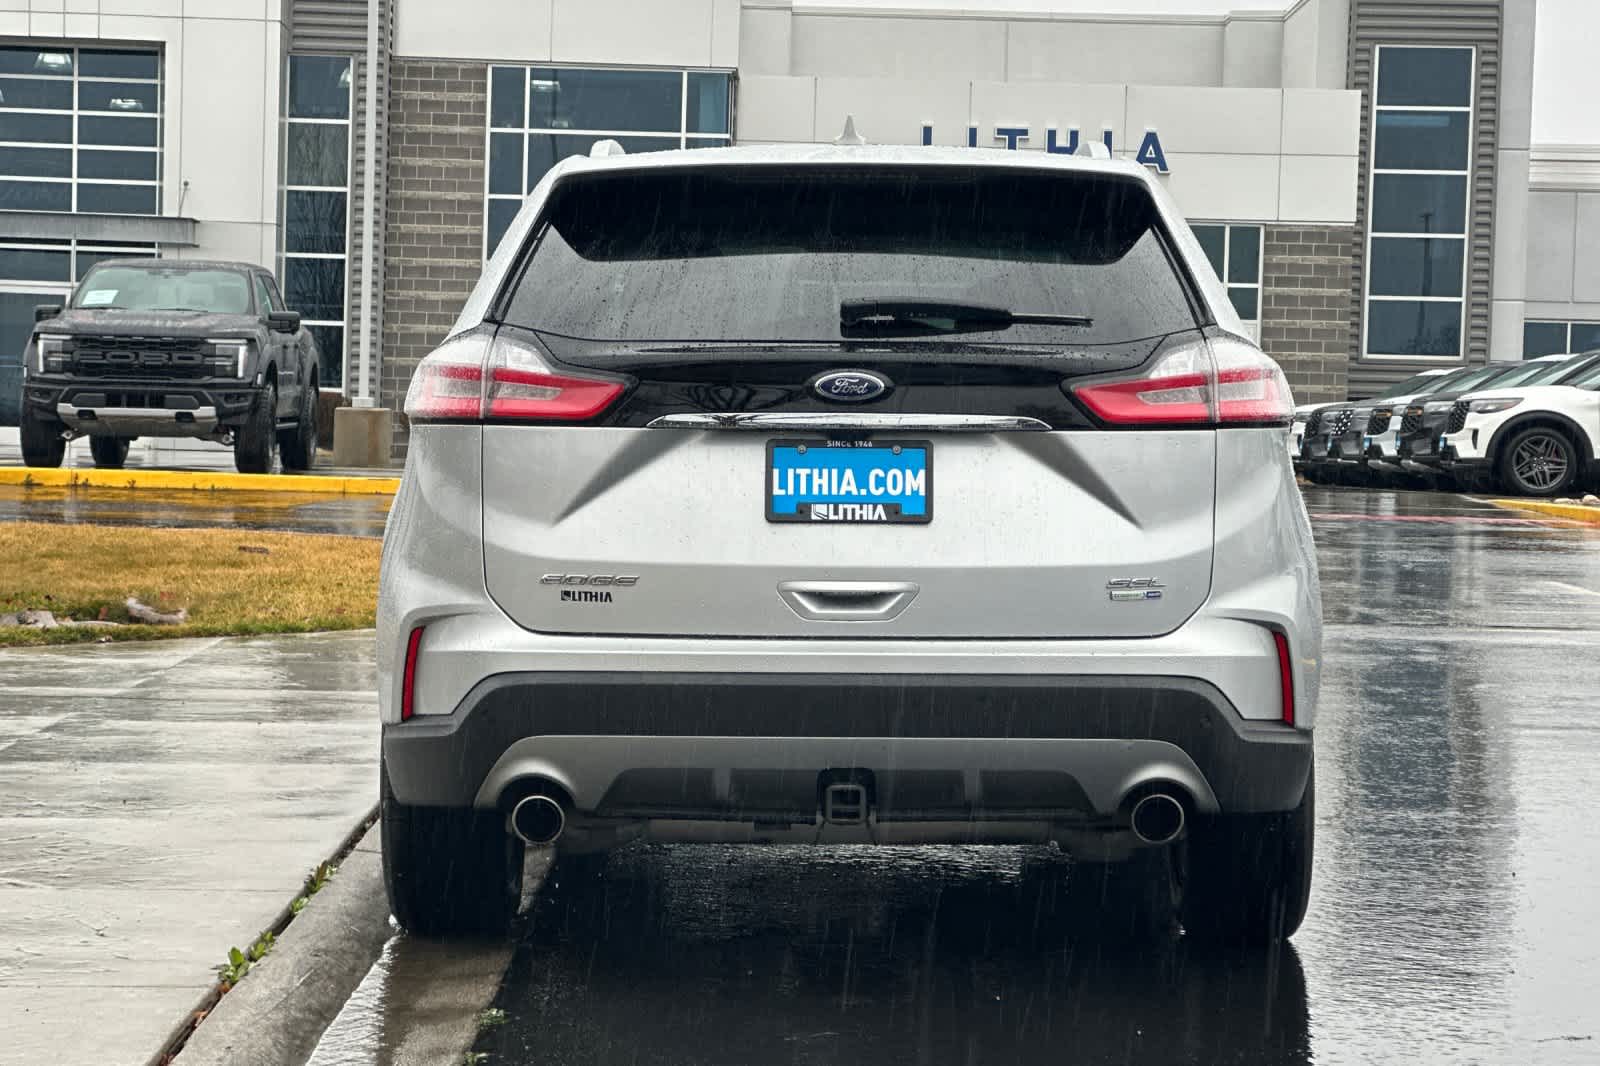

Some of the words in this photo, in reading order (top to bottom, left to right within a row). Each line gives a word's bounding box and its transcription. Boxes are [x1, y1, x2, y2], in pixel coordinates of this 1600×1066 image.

[72, 350, 204, 367] FORD
[831, 377, 869, 394] Ford
[826, 440, 852, 448] SINCE
[855, 440, 873, 448] 1946
[772, 468, 926, 496] LITHIA.COM
[829, 503, 888, 521] LITHIA
[539, 573, 641, 587] EDGE
[571, 590, 613, 603] LITHIA
